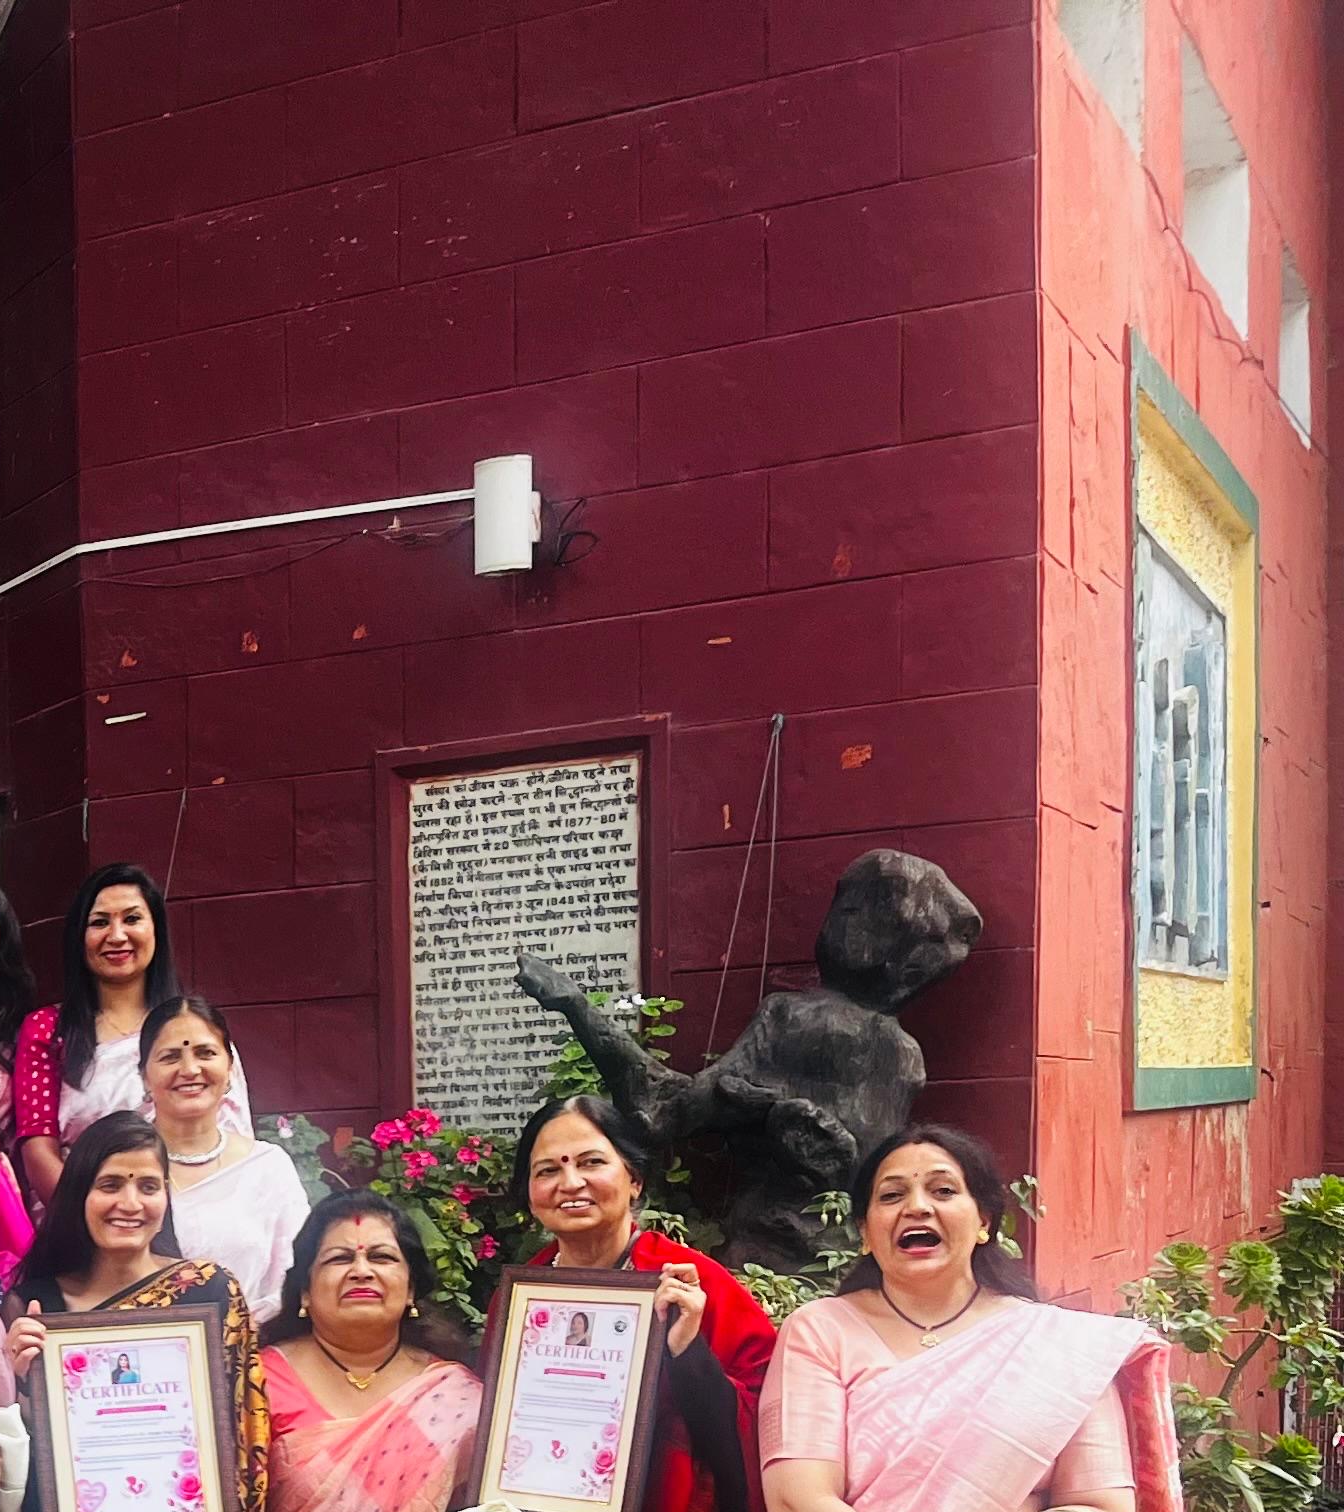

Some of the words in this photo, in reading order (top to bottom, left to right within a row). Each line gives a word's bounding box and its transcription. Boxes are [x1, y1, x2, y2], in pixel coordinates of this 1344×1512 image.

[608, 765, 631, 776] तथा
[494, 841, 509, 851] 20
[547, 866, 566, 878] एक
[496, 932, 509, 941] 27
[613, 919, 637, 930] भवन
[535, 1343, 624, 1362] CERTIFICATE
[80, 1381, 183, 1400] CERTIFICATE
